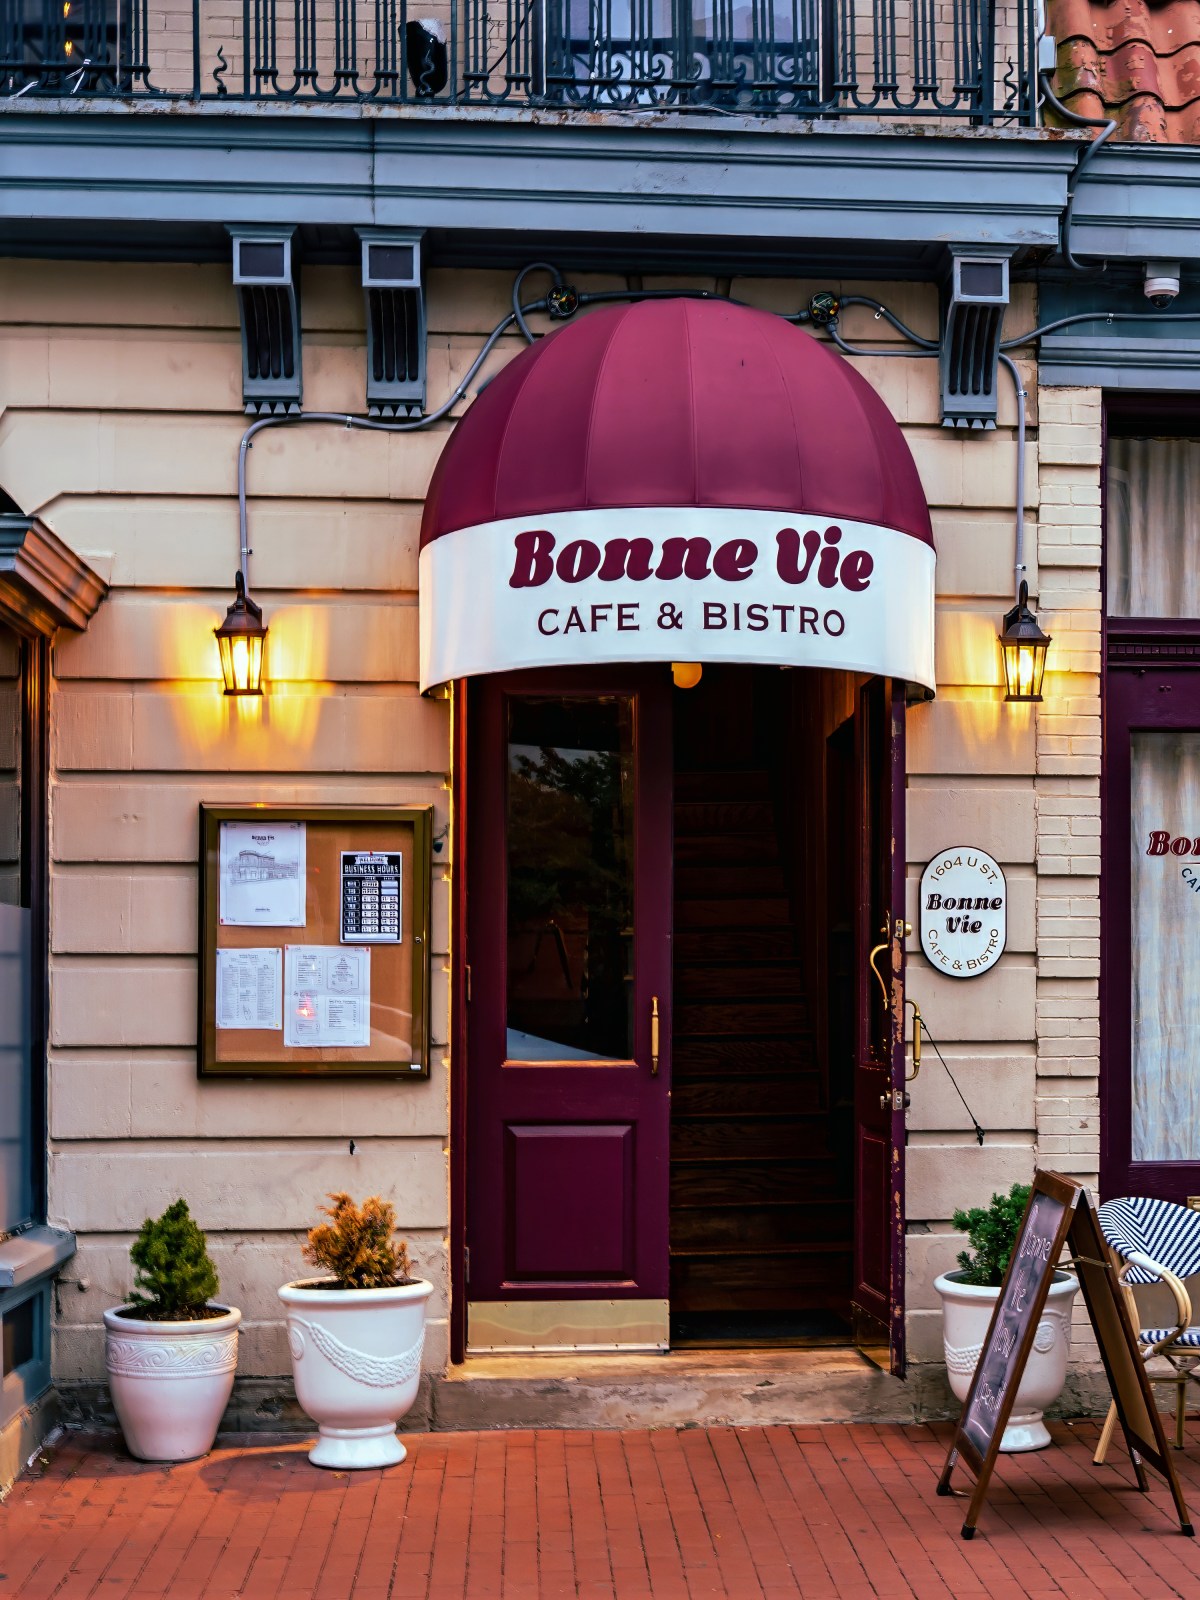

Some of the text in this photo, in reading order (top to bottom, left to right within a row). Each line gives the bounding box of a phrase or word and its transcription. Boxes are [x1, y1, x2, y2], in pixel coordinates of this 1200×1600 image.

[508, 525, 875, 592] Bonne Vie
[537, 601, 846, 637] CAFE & BISTRO
[930, 856, 998, 885] 1604 U ST.
[926, 893, 1003, 911] Bonne
[945, 914, 983, 934] Vie
[928, 928, 999, 971] CAFE & BISTRO
